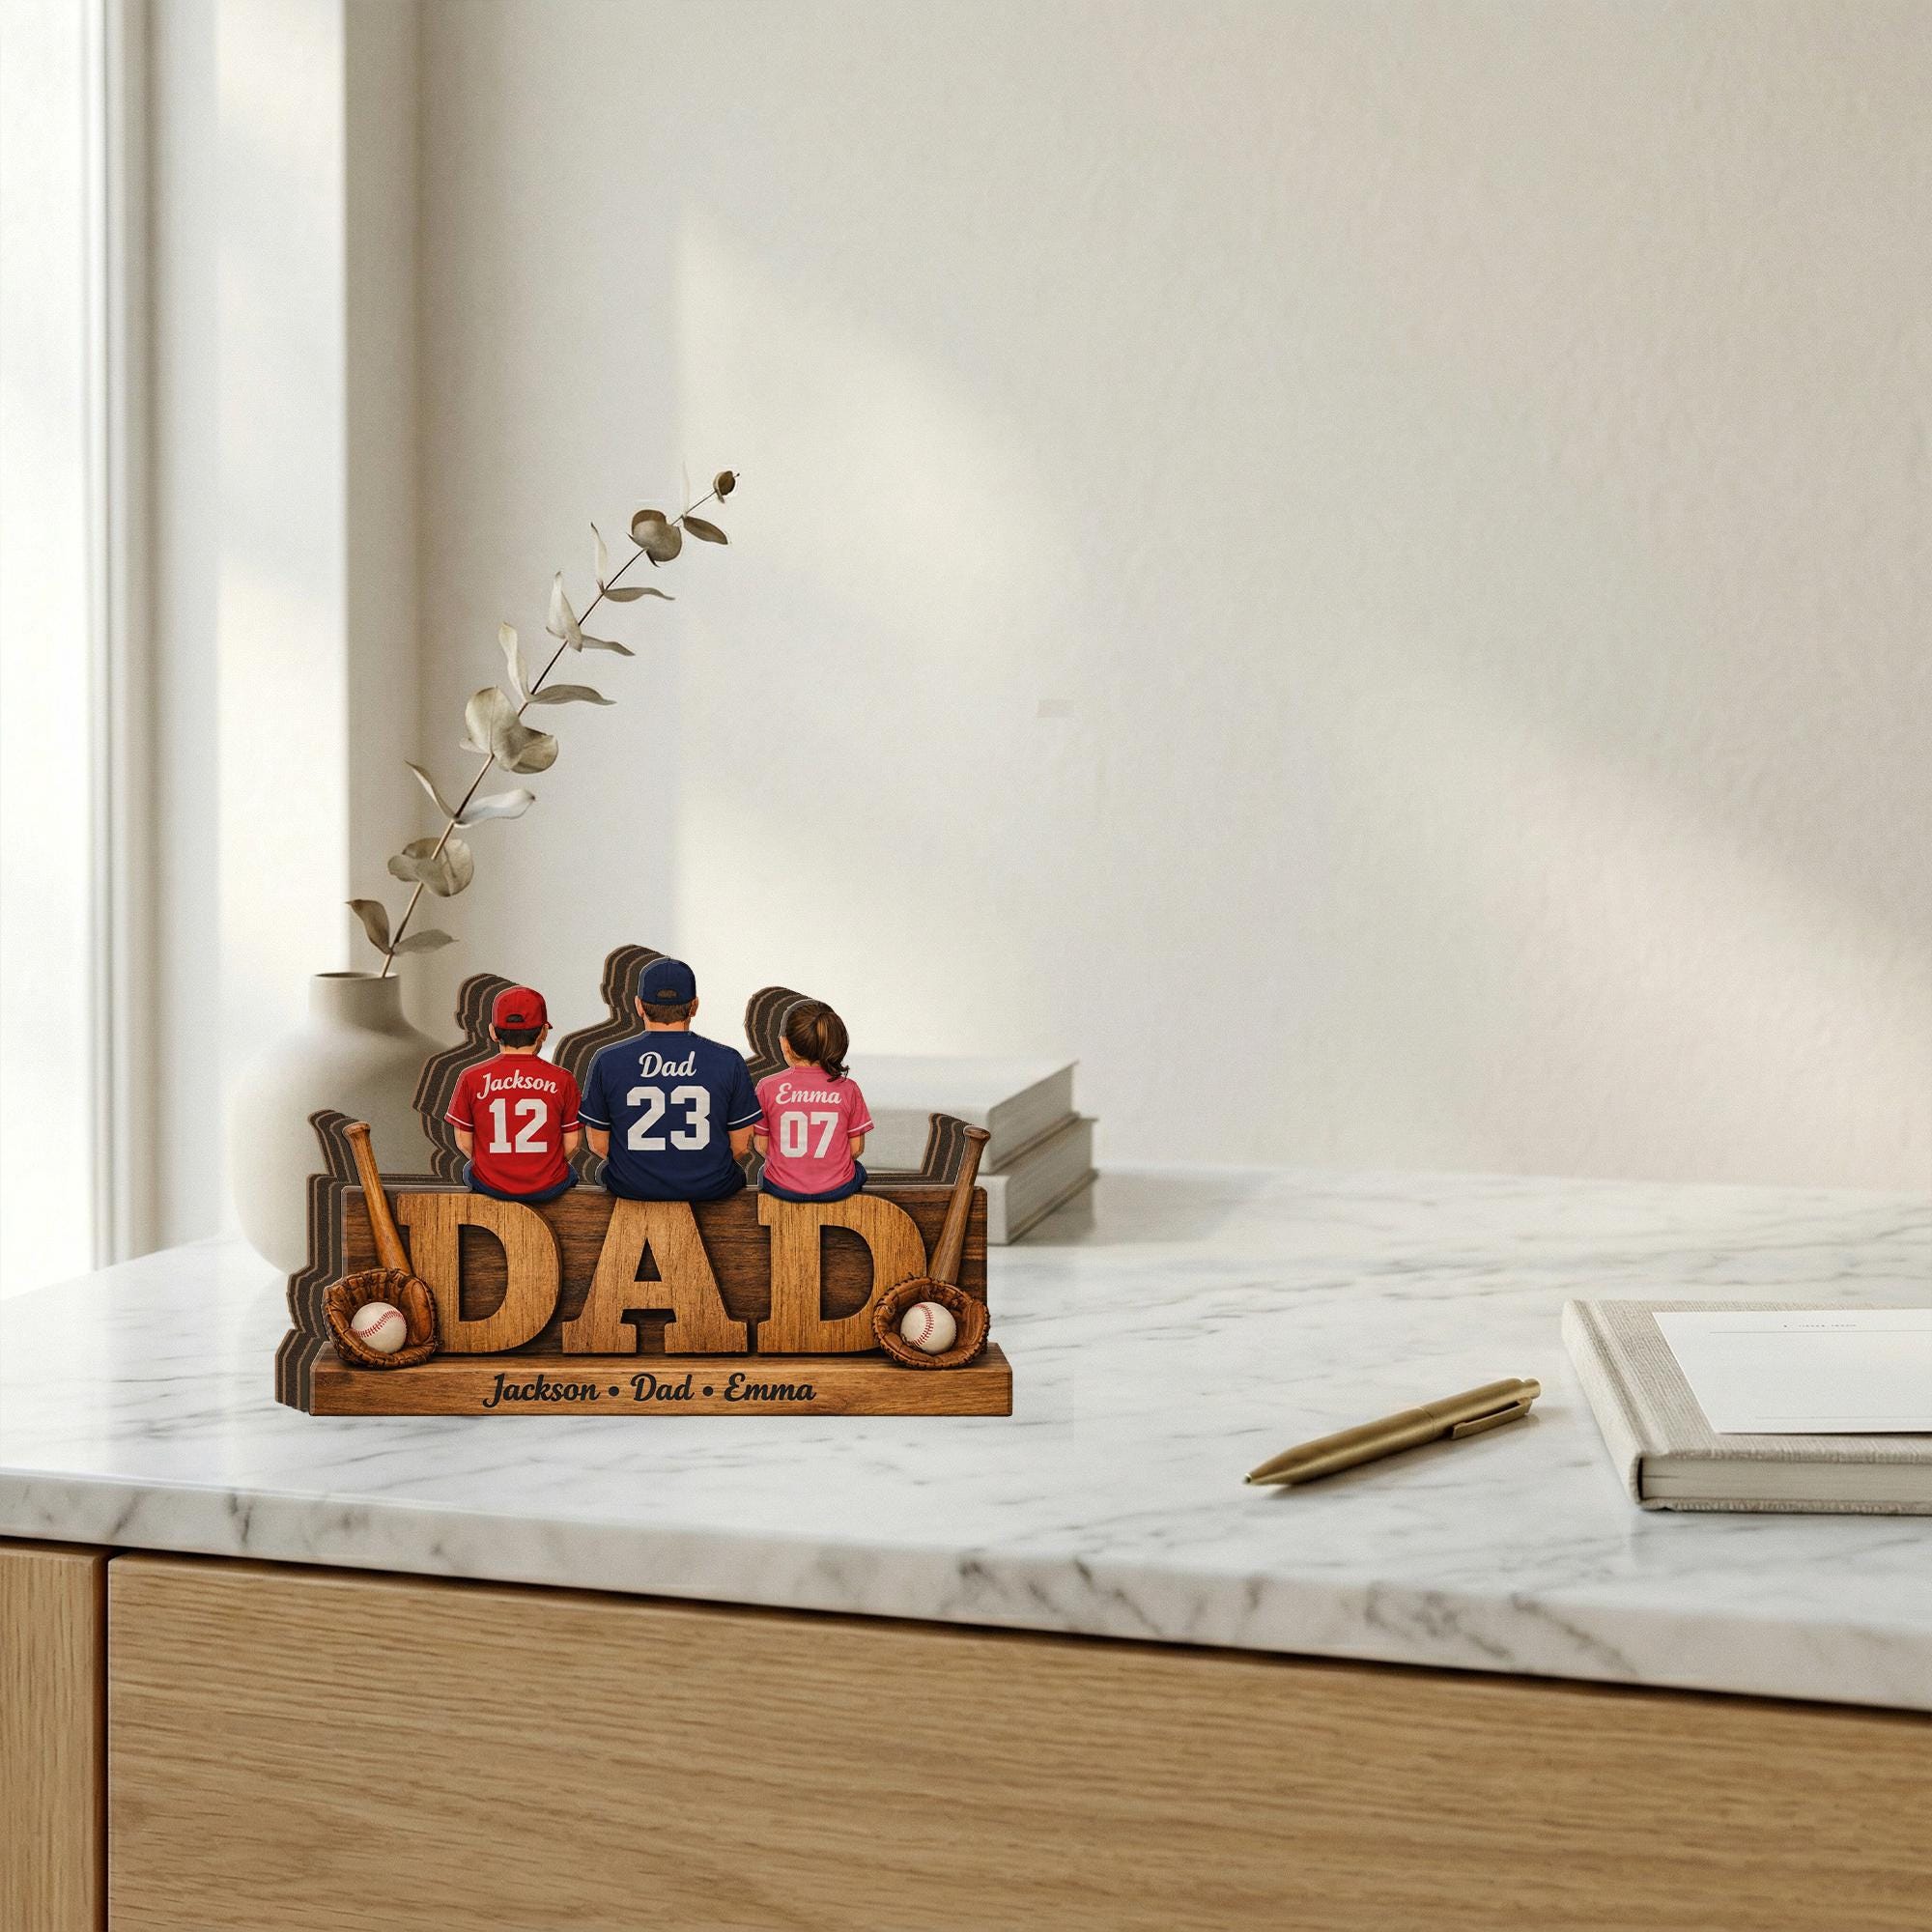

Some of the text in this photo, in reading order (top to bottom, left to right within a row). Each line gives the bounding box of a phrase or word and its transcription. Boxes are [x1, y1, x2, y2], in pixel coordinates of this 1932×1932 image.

[476, 1068, 558, 1100] Jackson
[638, 1050, 697, 1078] Dad
[775, 1081, 842, 1105] Emma
[489, 1097, 548, 1154] 12
[626, 1085, 711, 1151] 23
[780, 1110, 839, 1159] 07
[396, 1192, 928, 1353] DAD
[482, 1372, 817, 1408] Jackson Dad Emma
